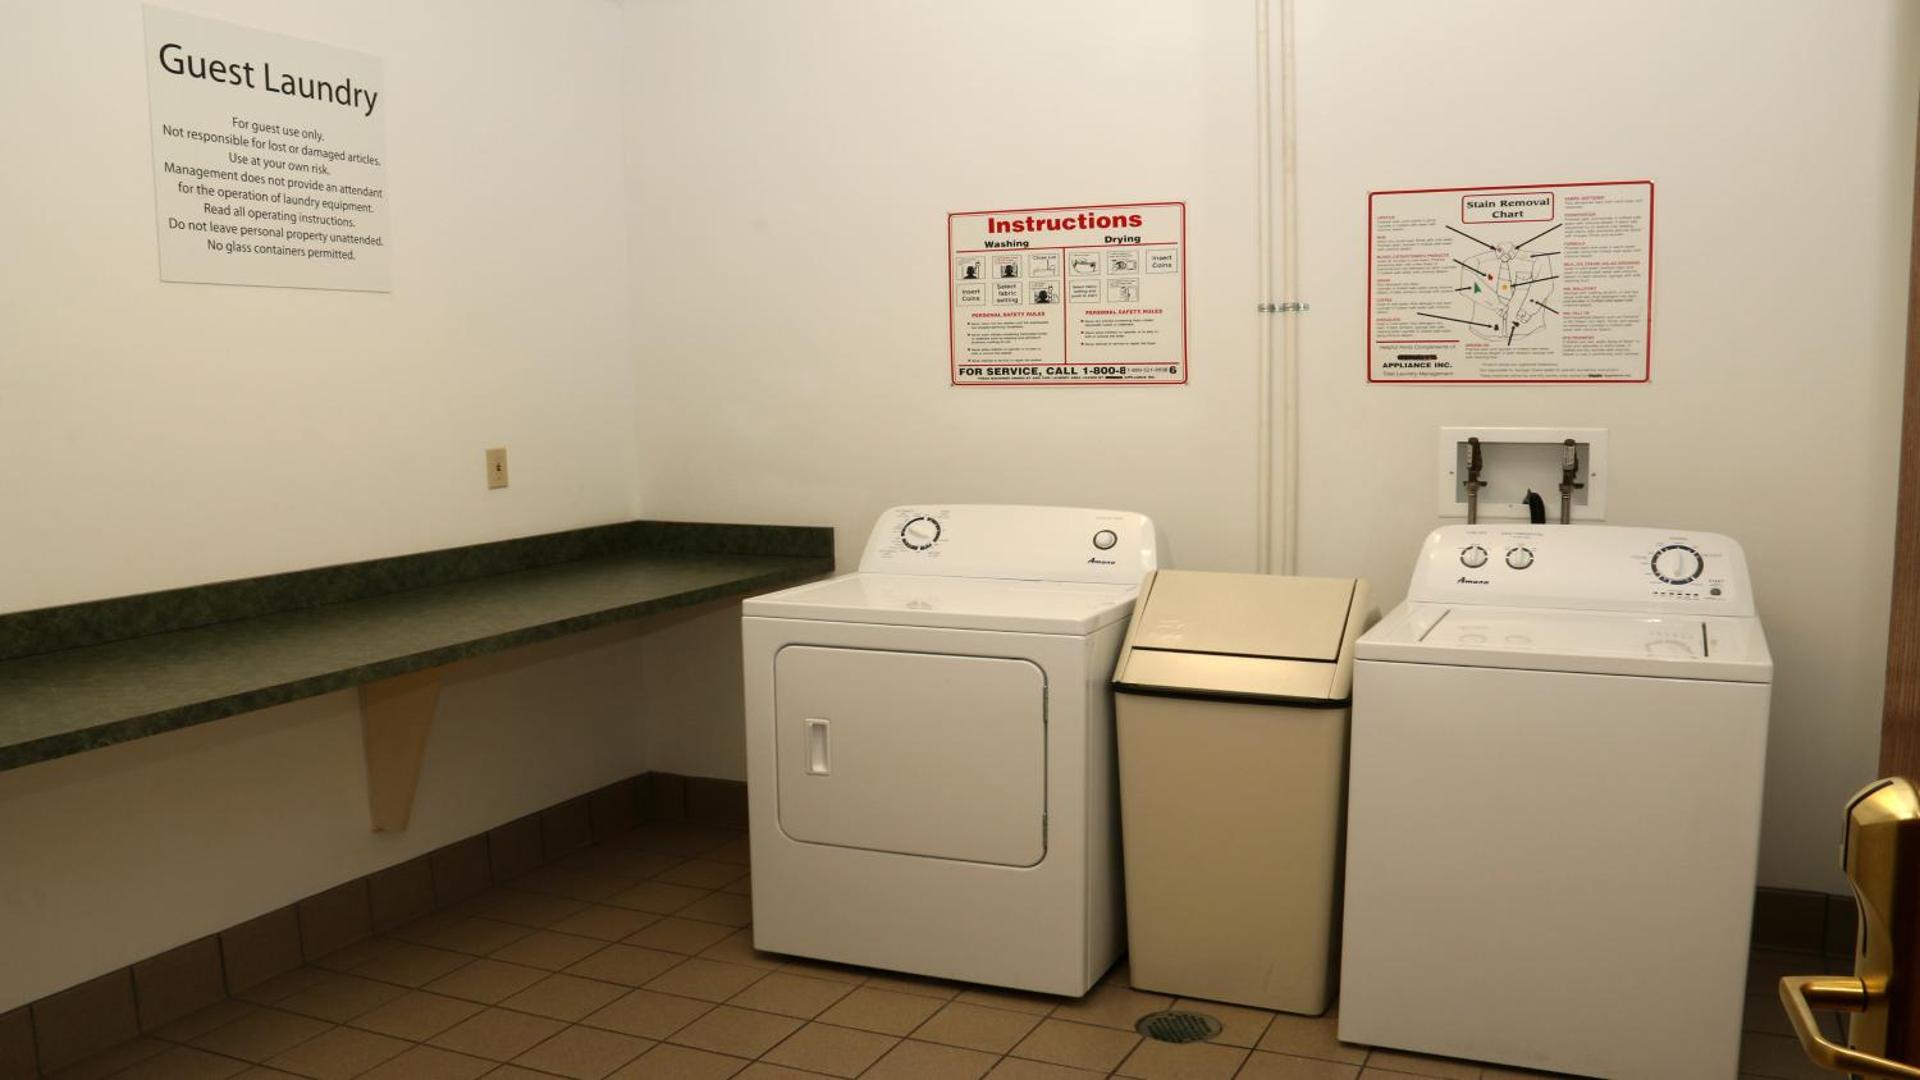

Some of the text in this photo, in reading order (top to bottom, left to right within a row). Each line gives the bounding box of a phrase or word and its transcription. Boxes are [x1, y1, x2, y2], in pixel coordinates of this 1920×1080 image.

[159, 43, 378, 117] Guest Laundry
[232, 117, 325, 143] For guest use only.
[162, 124, 382, 166] Not responsible for lost or damaged articles.
[228, 151, 331, 175] Use at your own risk.
[164, 161, 383, 198] Management does not provide an attendant
[178, 181, 375, 213] for the operation of laundry equipment.
[1466, 197, 1550, 209] Stain Removal
[204, 202, 356, 227] Read all operating instructions.
[988, 212, 1143, 234] Instructions
[1492, 210, 1524, 219] Chart
[168, 217, 384, 246] Do not leave personal property unattended.
[984, 234, 1141, 249] Washing Drying
[207, 239, 356, 260] No glass containers permitted.
[959, 367, 983, 376] FOR
[986, 366, 1042, 377] SERVICE,
[1046, 366, 1078, 375] CALL
